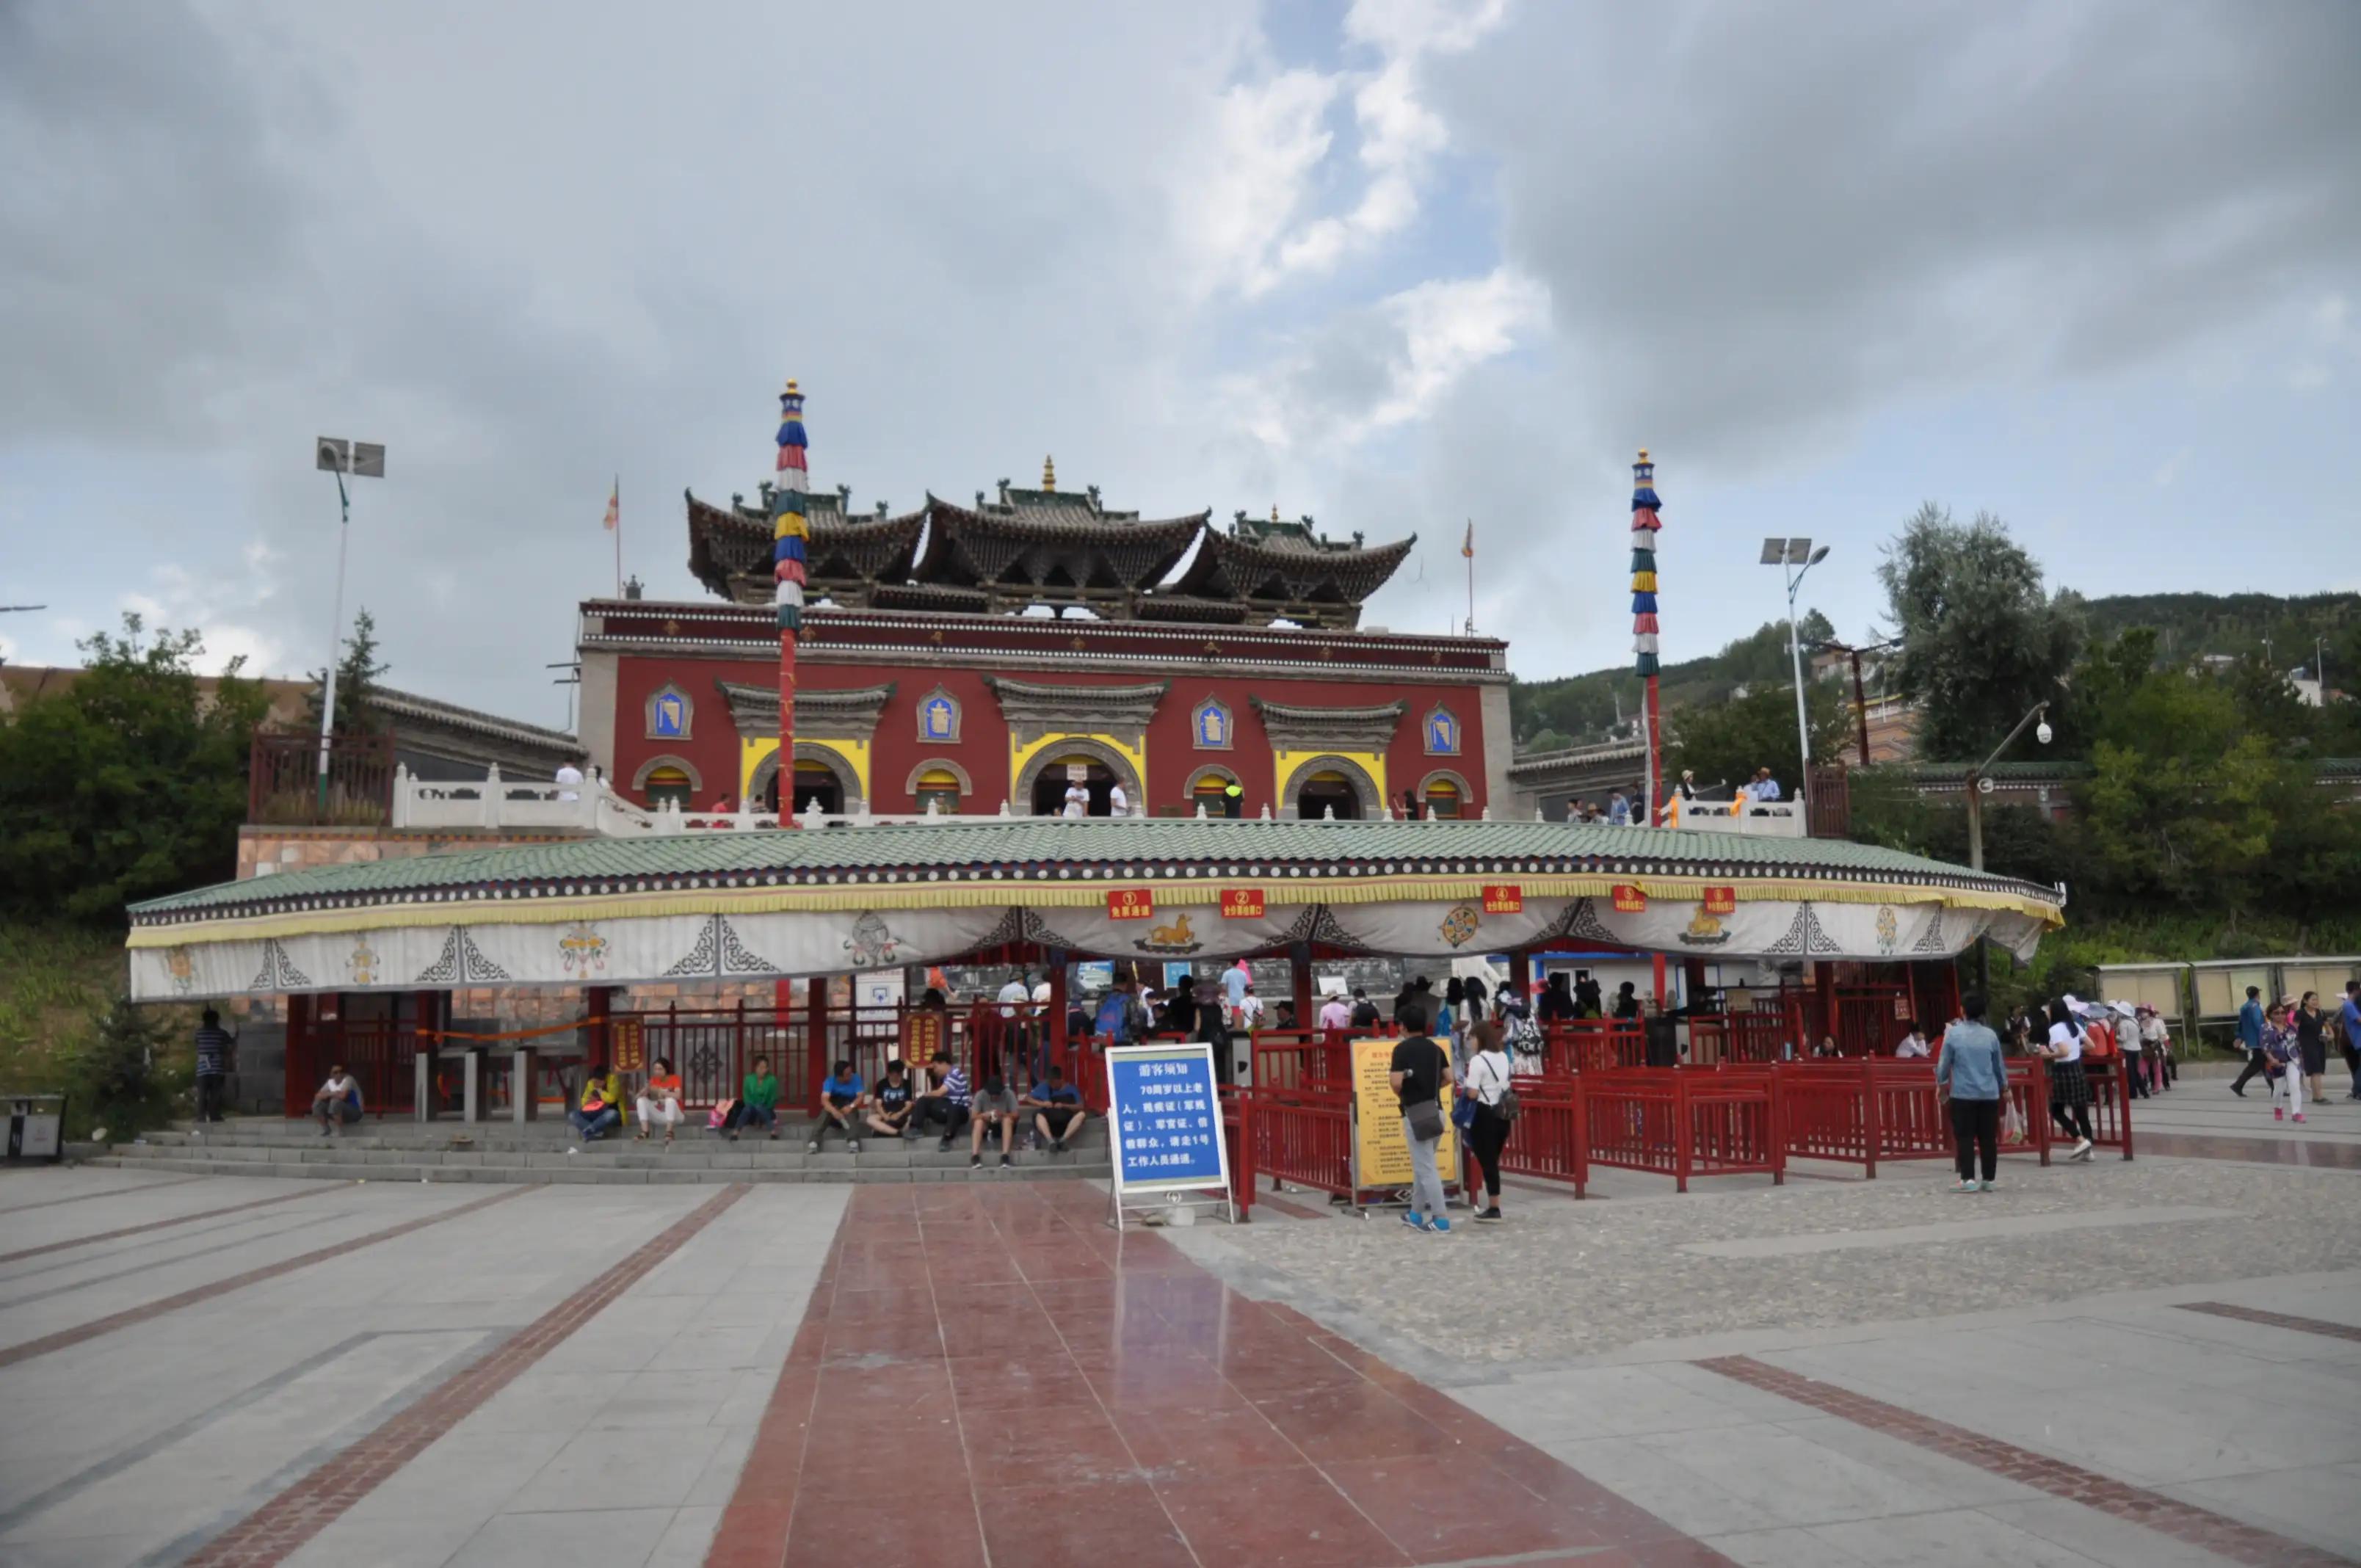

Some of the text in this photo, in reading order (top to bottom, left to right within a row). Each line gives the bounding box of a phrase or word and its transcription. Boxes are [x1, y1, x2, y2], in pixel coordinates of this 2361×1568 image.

[1139, 1063, 1188, 1077] 游客须知
[1140, 1082, 1203, 1096] 70周岁以上老
